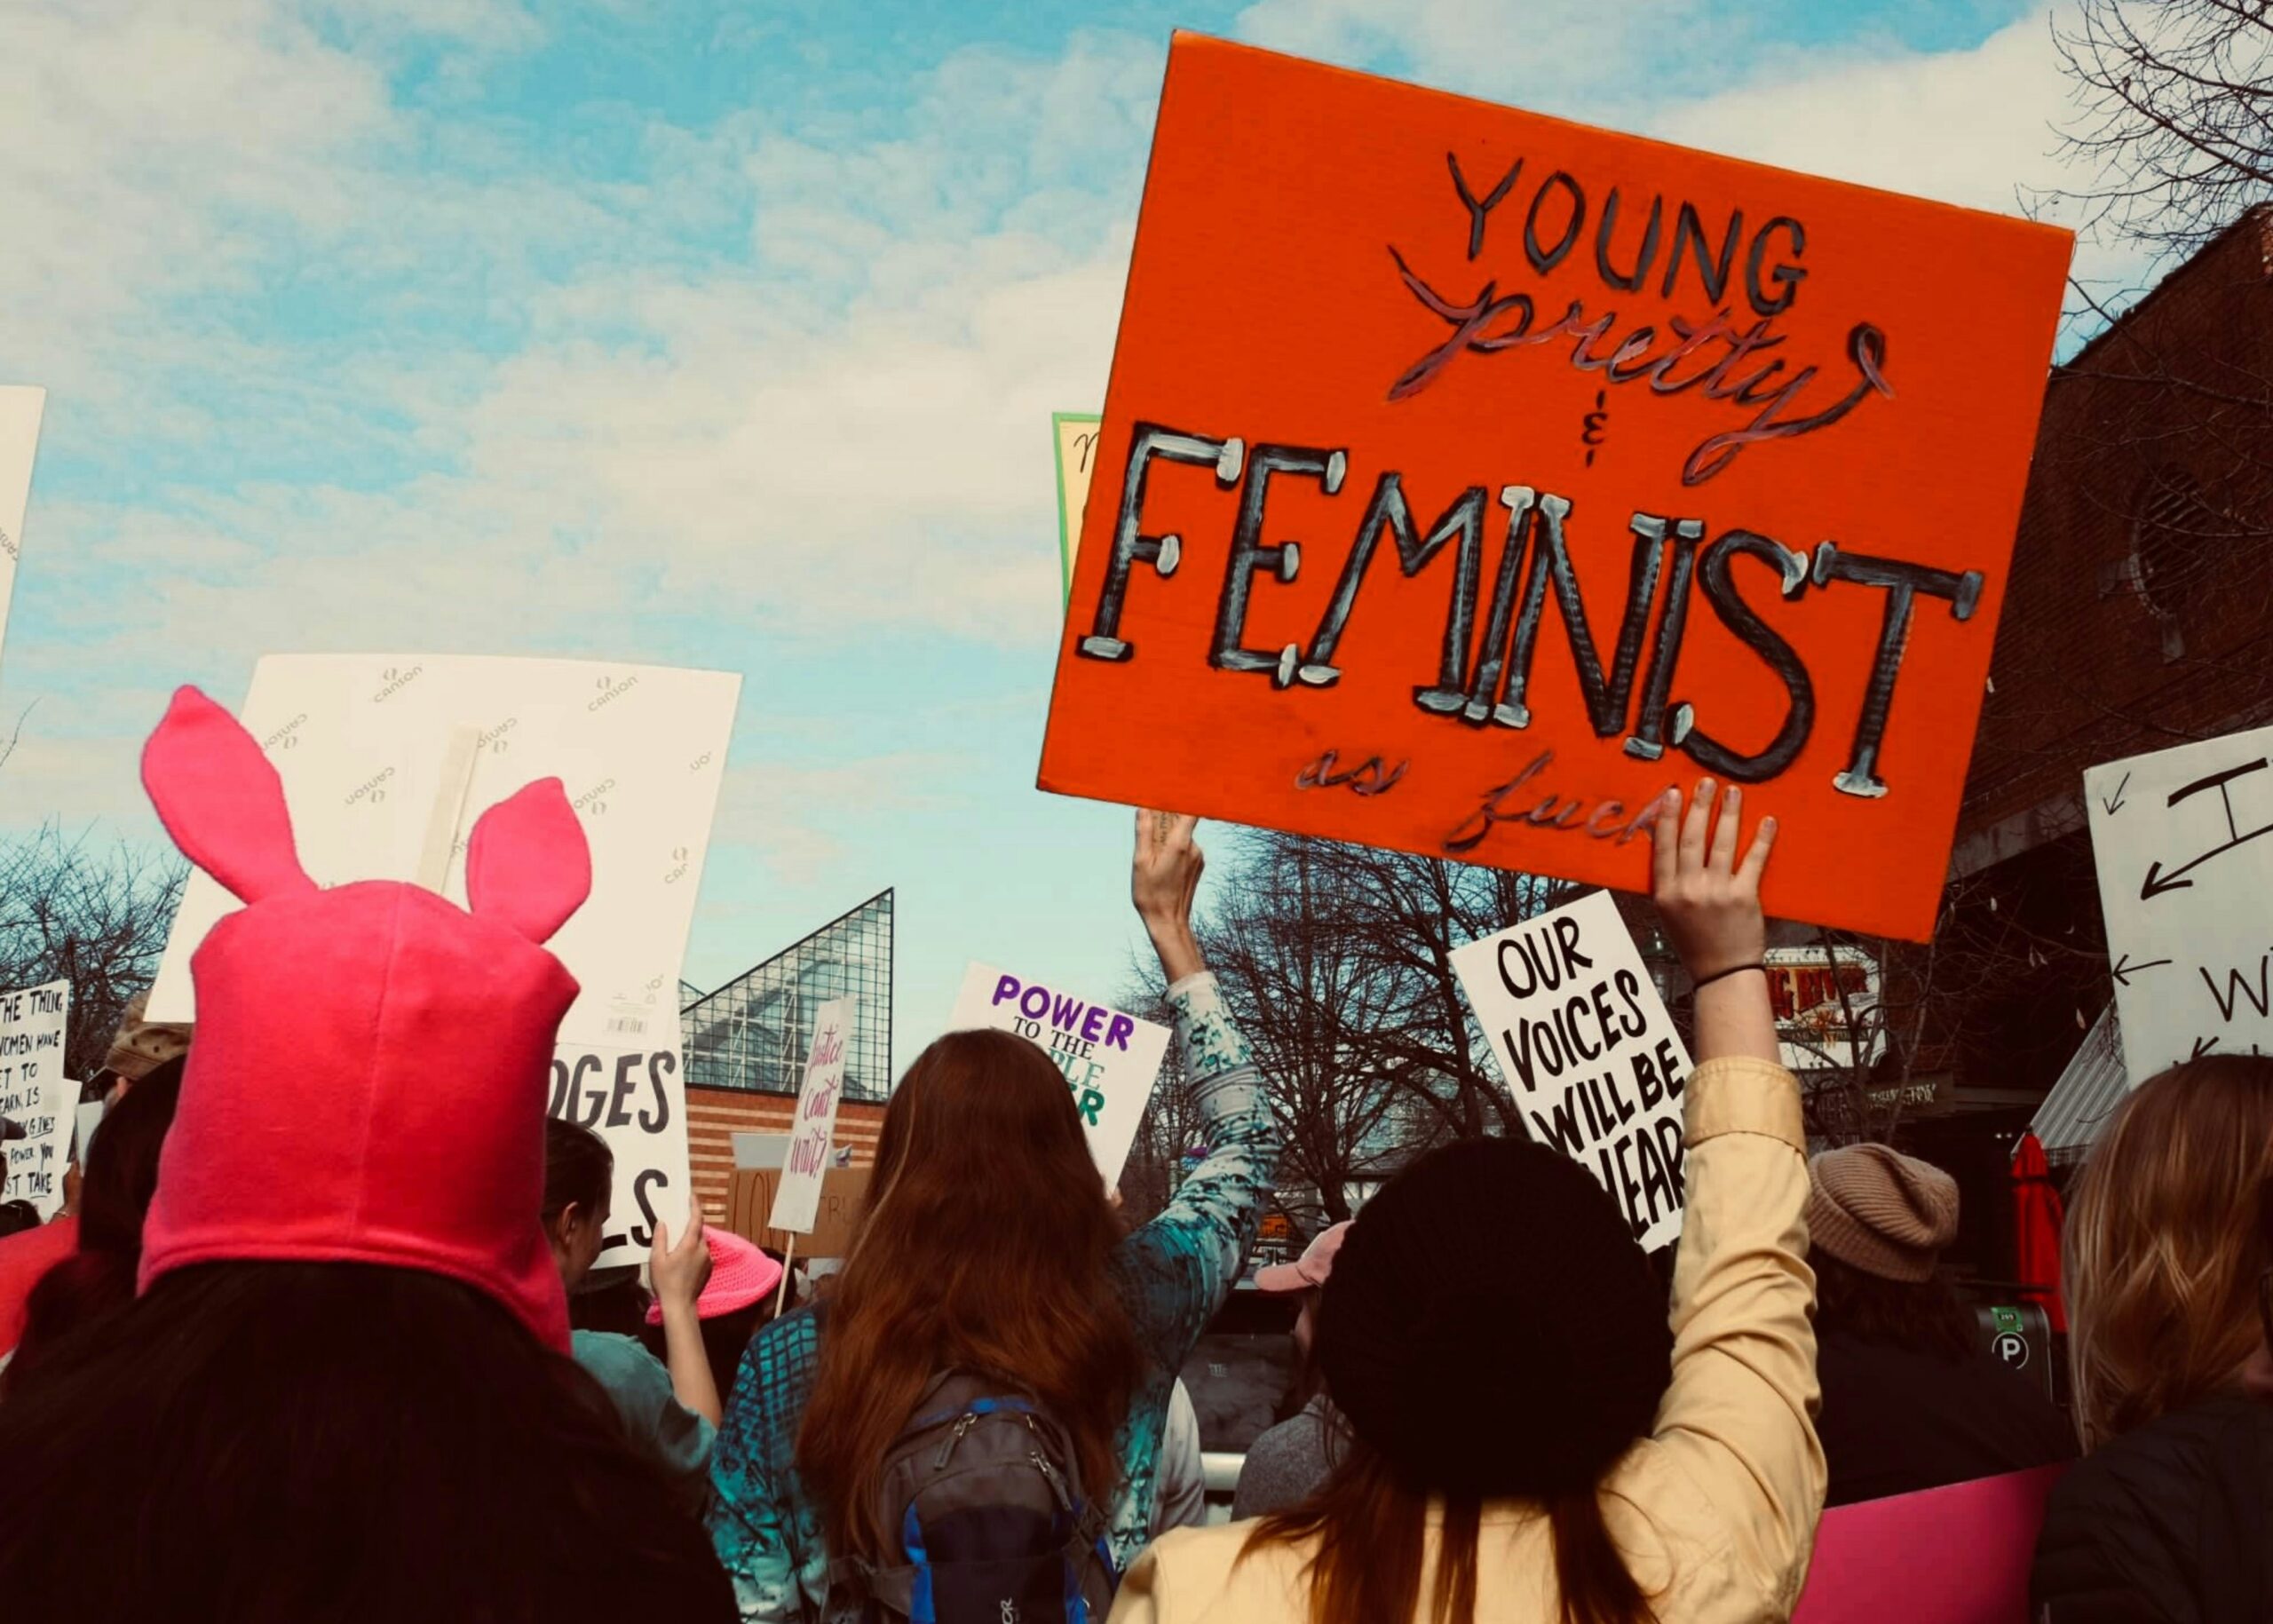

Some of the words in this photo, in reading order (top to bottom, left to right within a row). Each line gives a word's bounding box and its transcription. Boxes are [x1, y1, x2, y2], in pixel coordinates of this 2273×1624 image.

[1447, 151, 1808, 317] YOUNG
[1387, 243, 1895, 486] pretty
[1075, 420, 1984, 798] FEMINIST
[1295, 749, 1409, 795] as
[1497, 916, 1593, 1000] OUR
[36, 1030, 60, 1051] HAVE
[992, 974, 1135, 1051] POWER
[1013, 1017, 1041, 1040] TO
[1049, 1029, 1096, 1060] THE
[1502, 969, 1647, 1092] VOICES
[21, 1063, 38, 1081] TO
[26, 1086, 40, 1107] IS
[1049, 1048, 1105, 1090] PLE
[1530, 1072, 1635, 1154] WILL
[1631, 1037, 1685, 1112] BE
[2001, 1338, 2021, 1362] P
